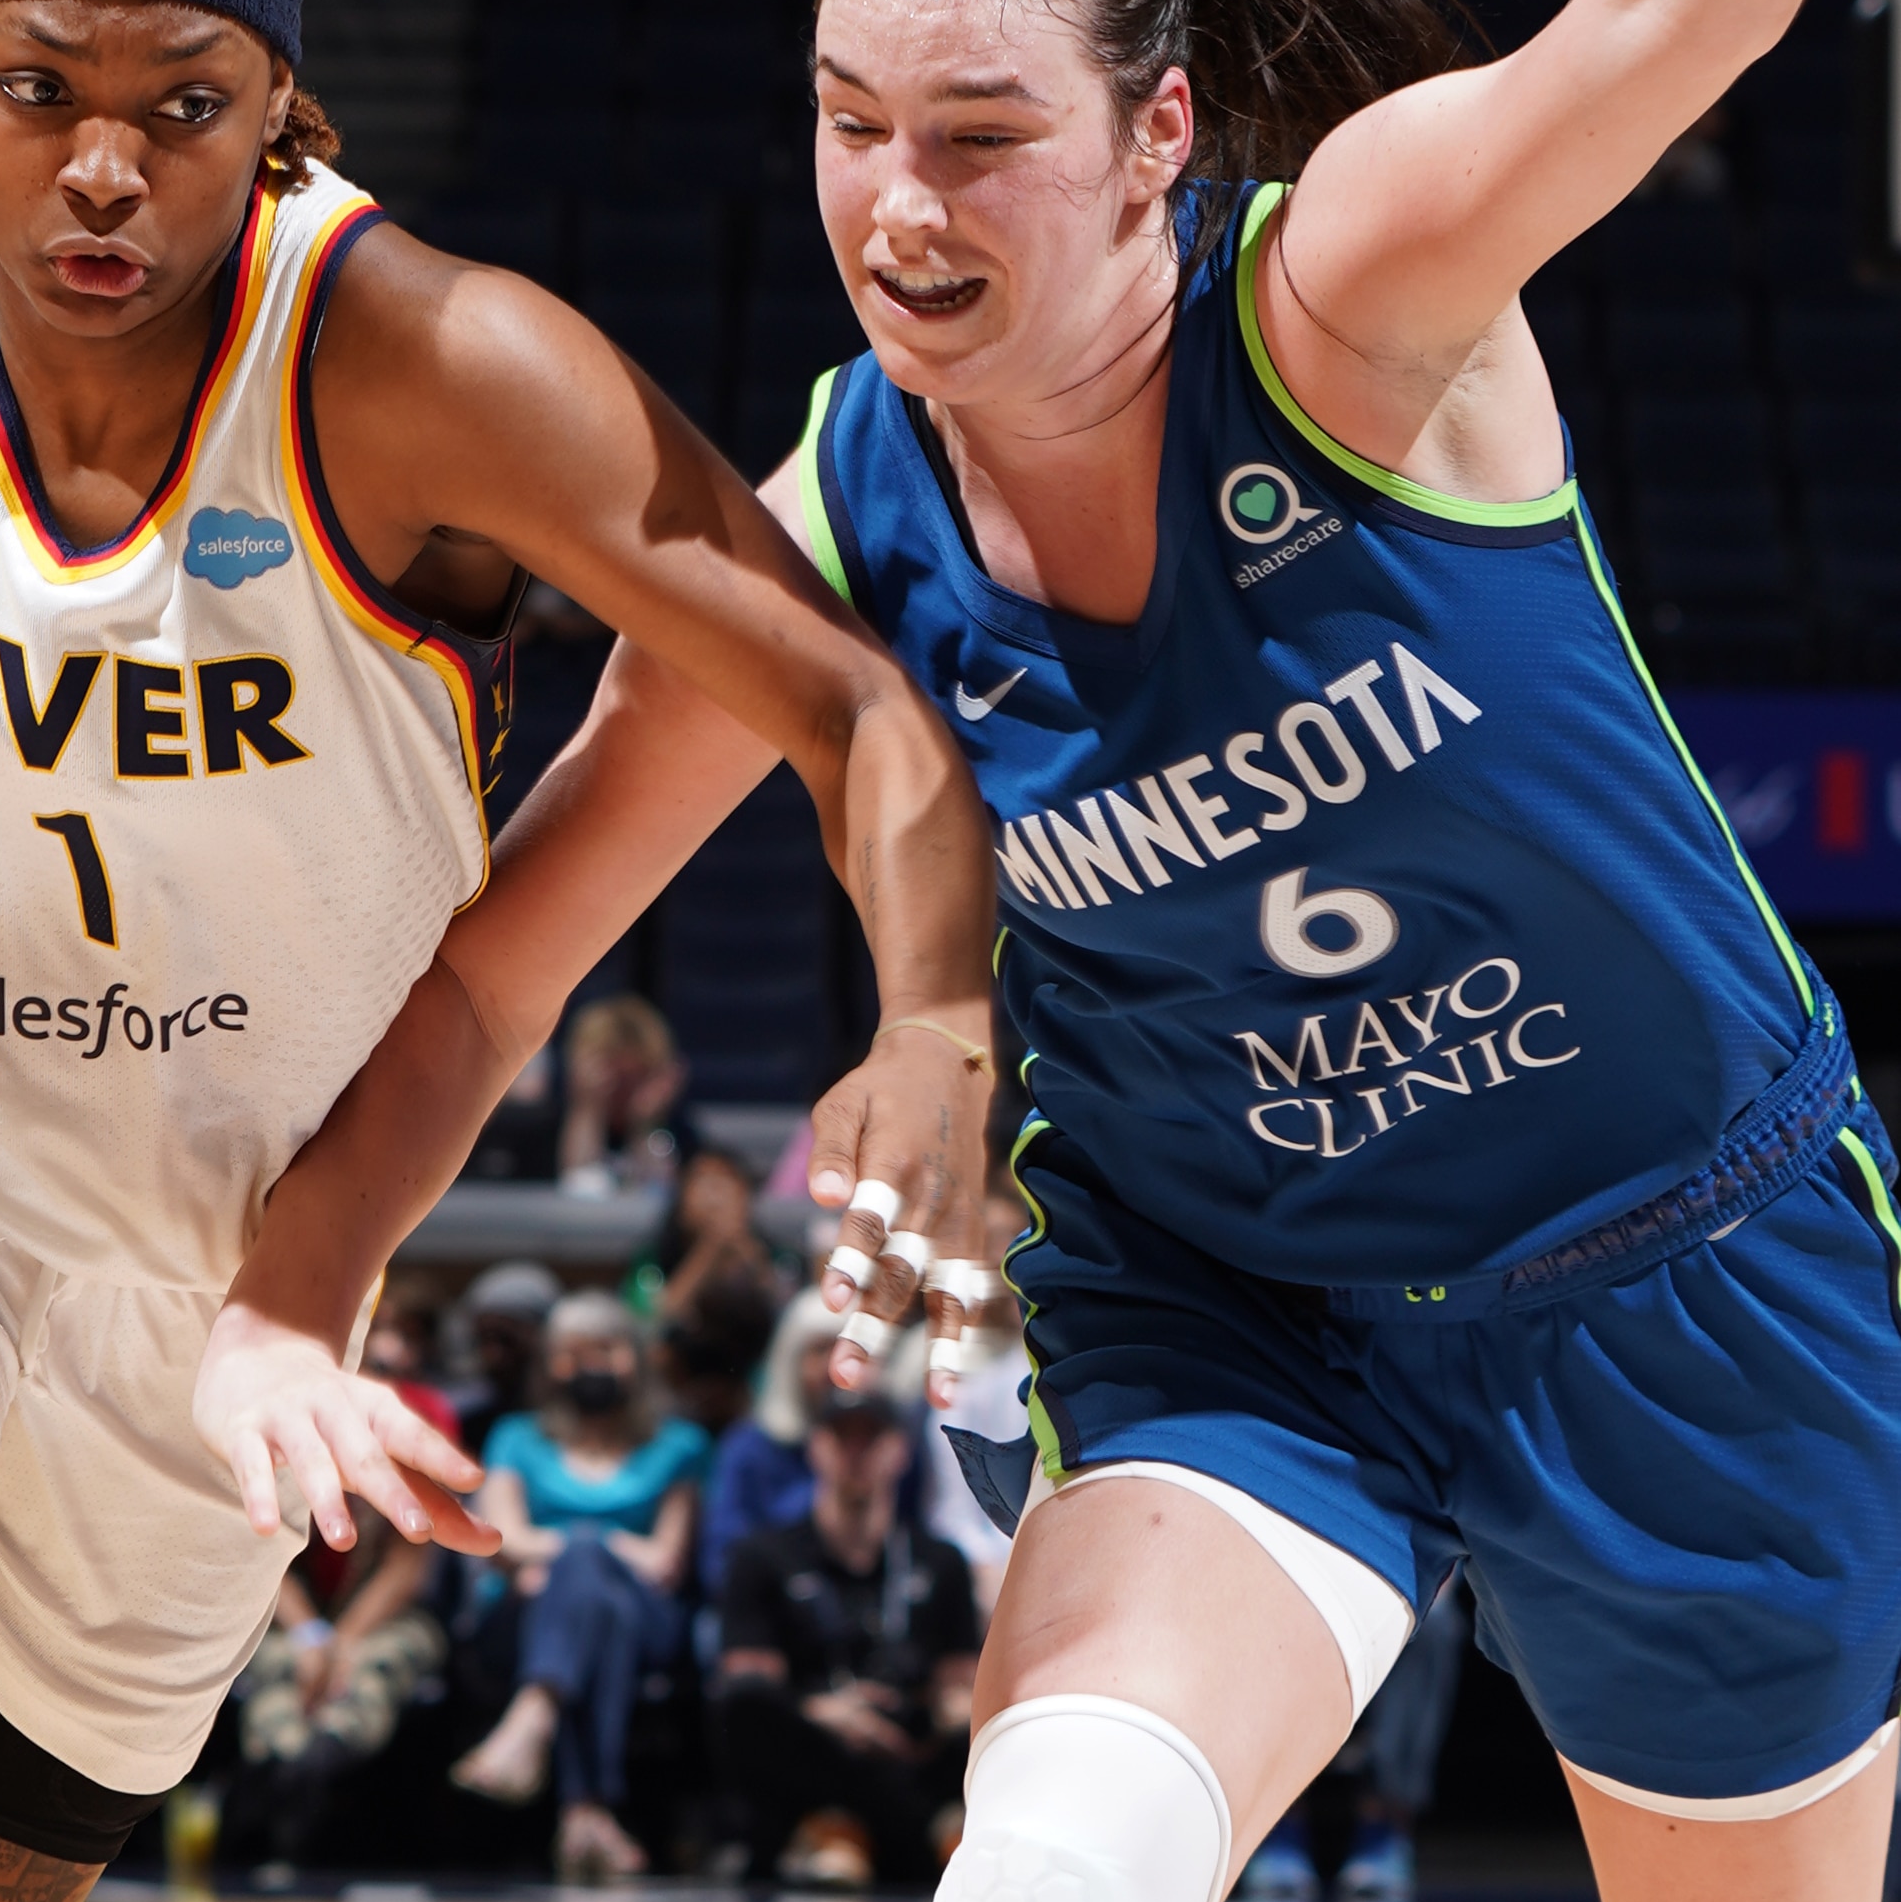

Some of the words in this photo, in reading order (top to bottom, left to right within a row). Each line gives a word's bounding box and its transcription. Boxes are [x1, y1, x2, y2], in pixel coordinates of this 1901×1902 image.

[198, 536, 285, 558] salesforce
[1235, 517, 1343, 589] sharecare
[994, 642, 1483, 910] MINNESOTA
[34, 810, 120, 951] 1
[1260, 865, 1400, 979] 6
[1232, 957, 1522, 1092] MAYO
[1248, 1003, 1581, 1159] CLINIC
